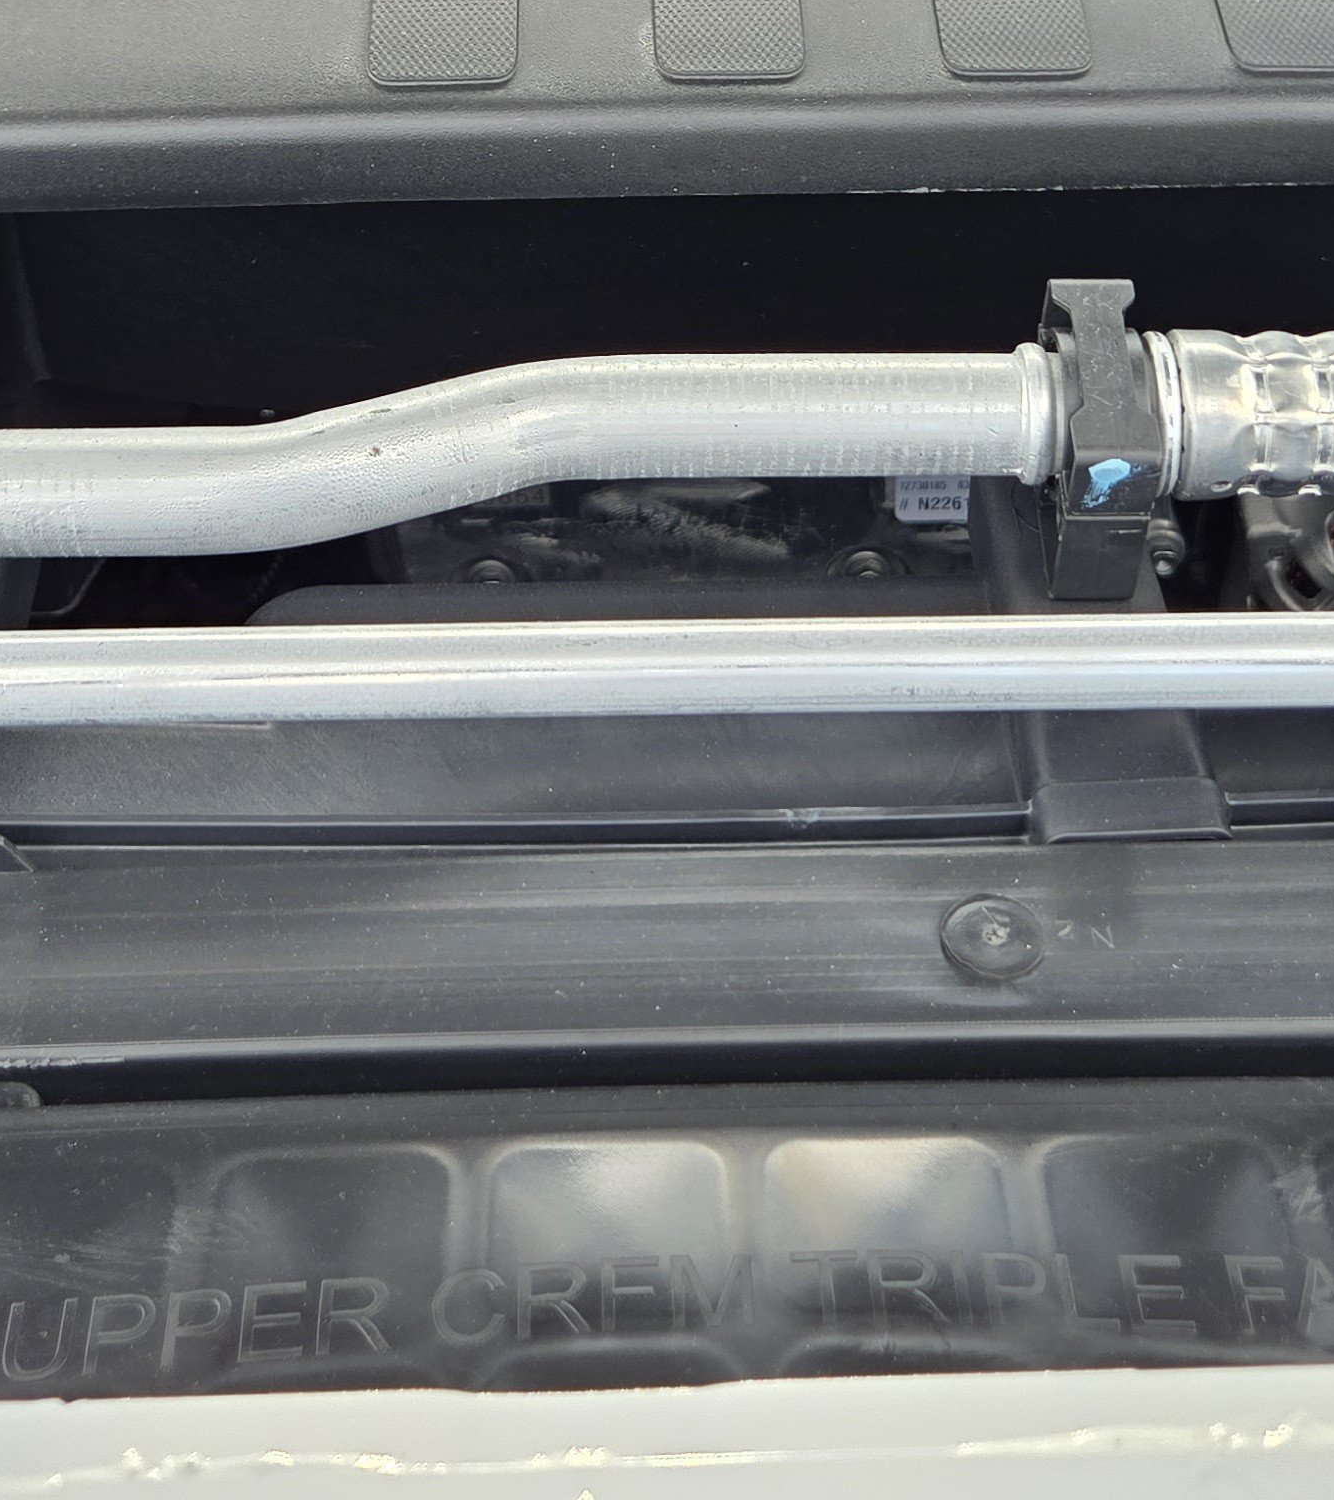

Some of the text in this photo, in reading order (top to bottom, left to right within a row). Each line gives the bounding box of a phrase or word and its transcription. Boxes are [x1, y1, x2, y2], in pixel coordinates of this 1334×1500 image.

[0, 1275, 393, 1382] UPPER
[430, 1252, 759, 1346] CRFM
[788, 1248, 1199, 1337] TRIPLE
